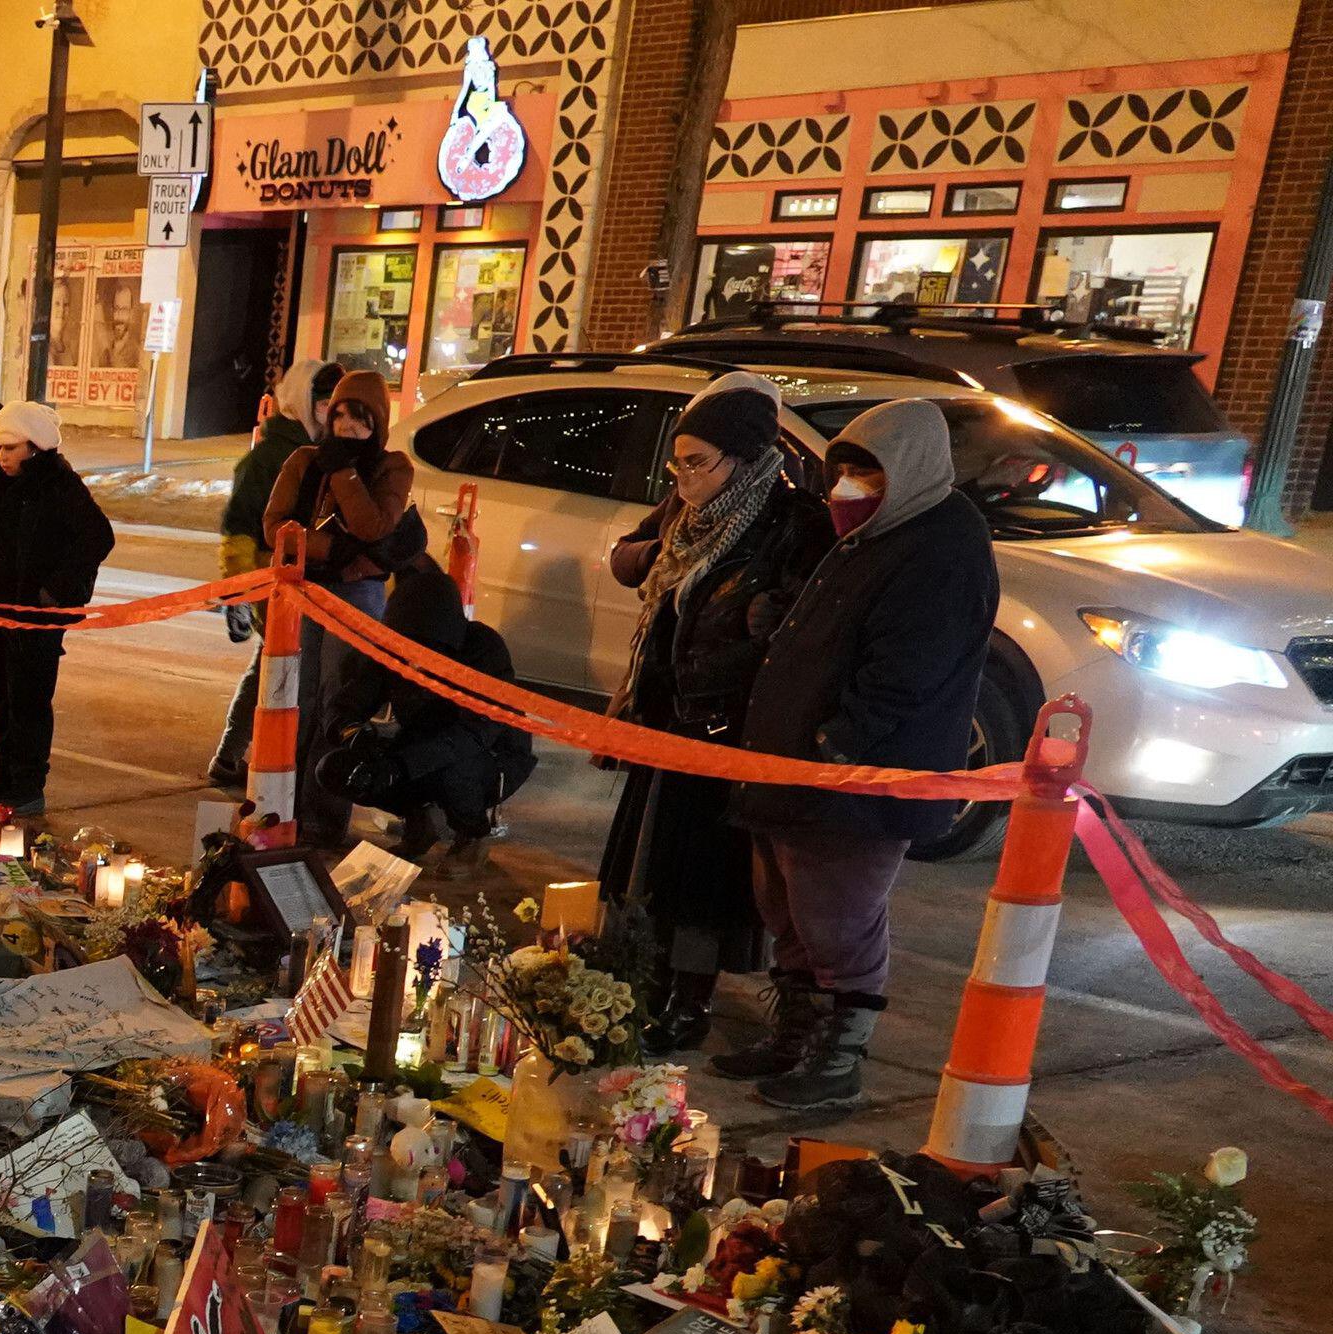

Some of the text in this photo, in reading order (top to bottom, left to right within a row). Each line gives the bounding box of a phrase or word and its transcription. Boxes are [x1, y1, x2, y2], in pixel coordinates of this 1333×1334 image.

[142, 154, 169, 169] ONLY
[250, 129, 388, 181] Glam Doll
[154, 184, 188, 198] TRUCK
[259, 179, 373, 203] DONUTS
[152, 201, 187, 215] ROUTE
[104, 250, 122, 260] ALEX
[119, 261, 143, 273] NURS
[51, 381, 78, 400] ICE
[88, 385, 109, 401] BY
